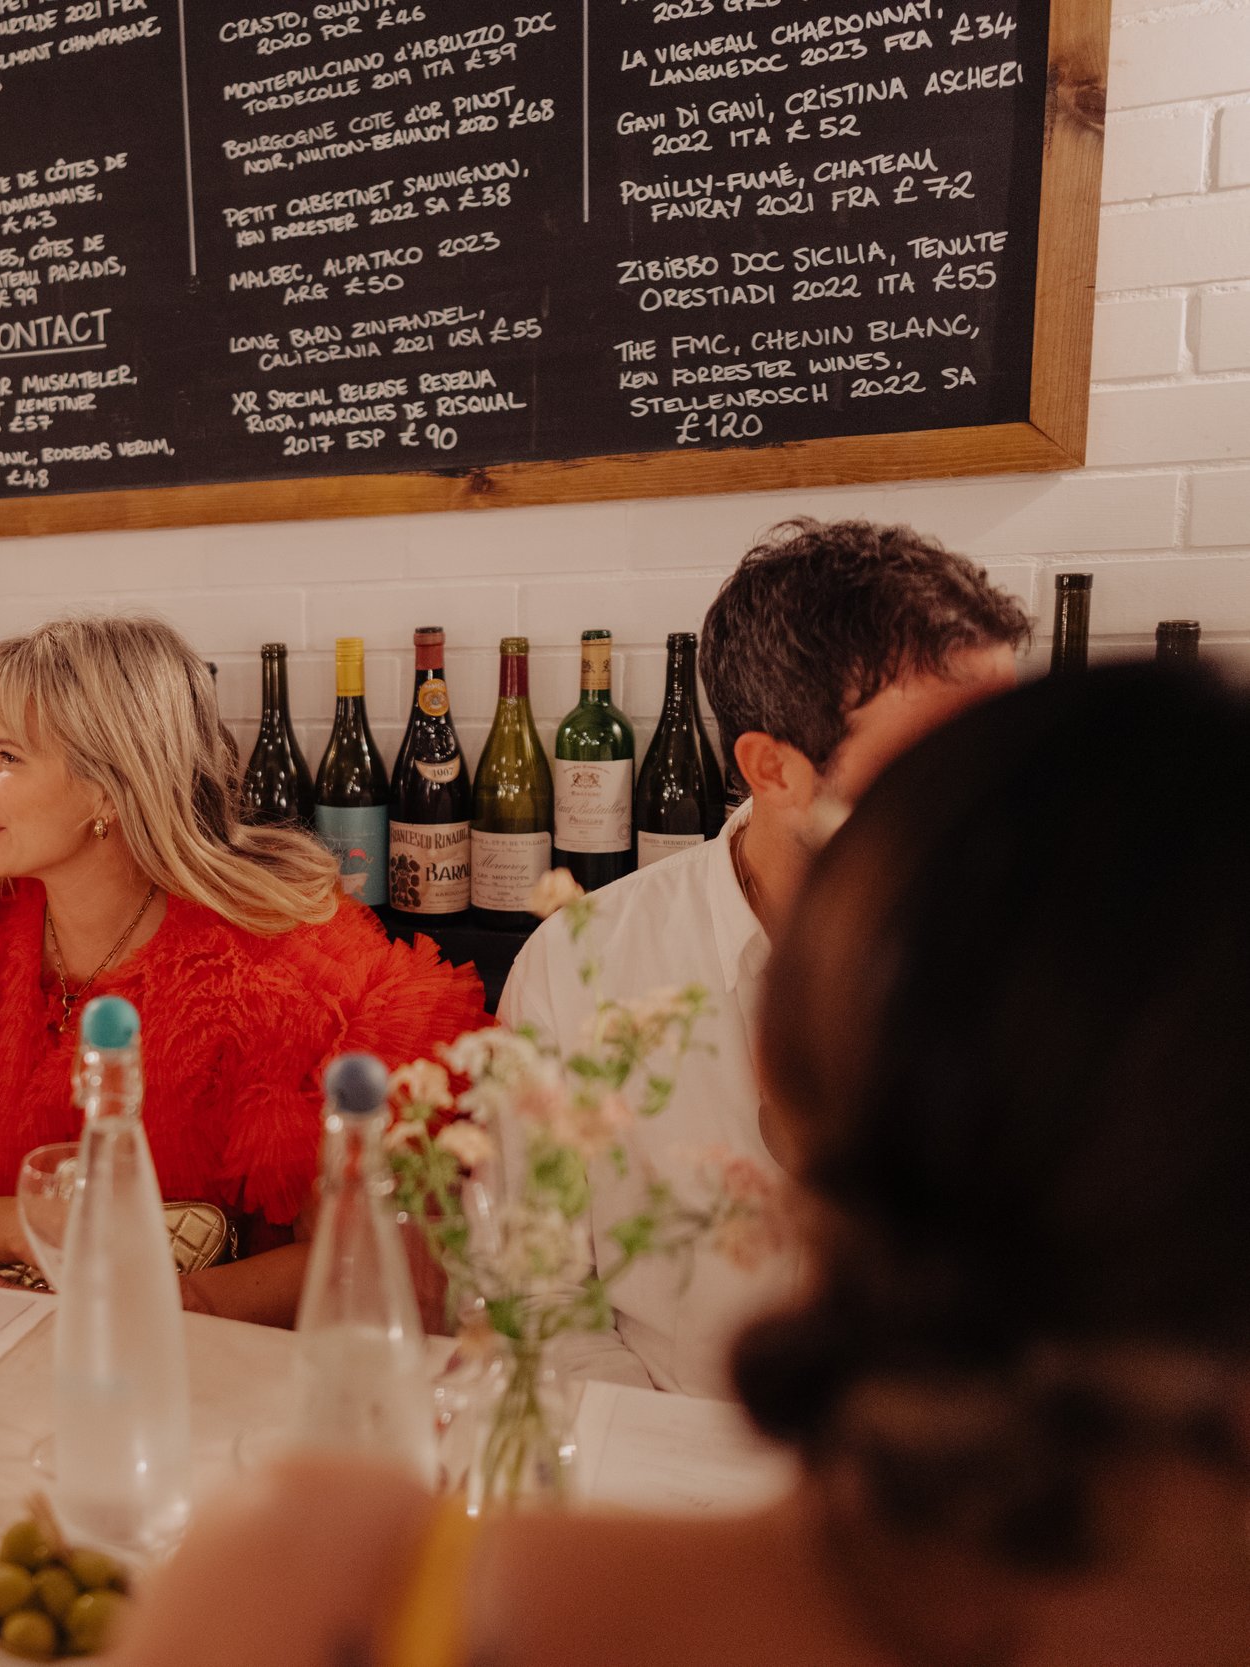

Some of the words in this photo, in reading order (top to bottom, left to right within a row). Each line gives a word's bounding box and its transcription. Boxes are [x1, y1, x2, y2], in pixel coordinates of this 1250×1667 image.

[64, 0, 102, 24] 2021
[219, 11, 308, 43] CRASTO,
[313, 0, 396, 20] QUIN
[257, 32, 312, 55] 2020
[319, 16, 363, 41] POR
[376, 5, 426, 30] £46
[652, 0, 715, 24] 2023
[58, 15, 162, 55] CHAMPAGNE,
[620, 49, 648, 72] LA
[654, 30, 759, 64] VIGNEAU
[771, 0, 944, 46] CHARDONNAY,
[649, 53, 789, 87] LANGUEDOC
[800, 38, 868, 67] 2023
[883, 29, 933, 54] FRA
[949, 11, 1017, 46] £34
[223, 52, 385, 101] MONTEPULCIANO
[513, 11, 557, 38] DOC
[242, 78, 361, 116] TORDECOLLE
[371, 68, 412, 90] 2019
[423, 58, 455, 79] ITA
[464, 42, 517, 72] £39
[924, 60, 1024, 97] ASCHERI
[222, 120, 338, 160] BOURGOGNE
[348, 110, 396, 134] COTE
[452, 85, 516, 117] PINOT
[244, 152, 295, 176] NOIR,
[456, 114, 499, 135] 2020
[508, 98, 555, 129] £68
[652, 129, 713, 156] 2022
[730, 126, 771, 148] ITA
[16, 169, 39, 189] DE
[44, 158, 100, 183] CÔTES
[104, 152, 128, 172] DE
[813, 147, 939, 183] CHATEAU
[222, 203, 278, 228] PETIT
[236, 229, 266, 248] KEN
[271, 212, 359, 242] FORRESTER
[369, 201, 420, 225] 2022
[424, 196, 451, 216] SA
[458, 182, 512, 211] £38
[756, 191, 814, 216] 2021
[831, 185, 881, 212] FRA
[28, 236, 74, 261] CÔTES
[83, 234, 105, 253] DE
[229, 263, 313, 292] MALBEC,
[323, 246, 423, 277] ALPATACO
[438, 231, 501, 258] 2023
[730, 251, 785, 276] DOC
[792, 241, 896, 273] SICILIA,
[906, 231, 1009, 259] TENUTE
[48, 255, 127, 284] PARADIS,
[791, 274, 862, 302] 2022
[878, 271, 915, 295] ITA
[932, 261, 997, 293] £55
[283, 283, 329, 306] ARG
[343, 273, 405, 296] £50
[230, 333, 280, 353] LONG
[289, 325, 342, 348] BARN
[351, 305, 485, 339] ZINFANDEL,
[392, 334, 434, 354] 2021
[448, 326, 484, 347] USA
[489, 317, 542, 343] £55
[613, 339, 657, 362] THE
[671, 334, 740, 359] FMC,
[751, 325, 853, 351] CHENIN
[867, 313, 980, 342] BLANC,
[619, 370, 659, 390] KEN
[672, 359, 797, 387] FORRESTER
[809, 351, 902, 374] WINES,
[232, 390, 261, 416] XR
[267, 388, 333, 411] SPECIAL
[338, 378, 409, 403] RELEASE
[309, 403, 397, 427] MARQUES
[401, 400, 428, 421] DE
[436, 391, 527, 417] RISQUAL
[630, 382, 829, 418] STELLENBOSCH
[850, 371, 927, 398] 2022
[941, 366, 977, 390] SA
[8, 414, 54, 433] £57
[283, 434, 336, 456] 2017
[345, 428, 386, 450] ESP
[675, 411, 763, 444] £120
[41, 441, 113, 463] BODEGAS
[6, 468, 50, 489] £48
[426, 862, 470, 882] BAROL
